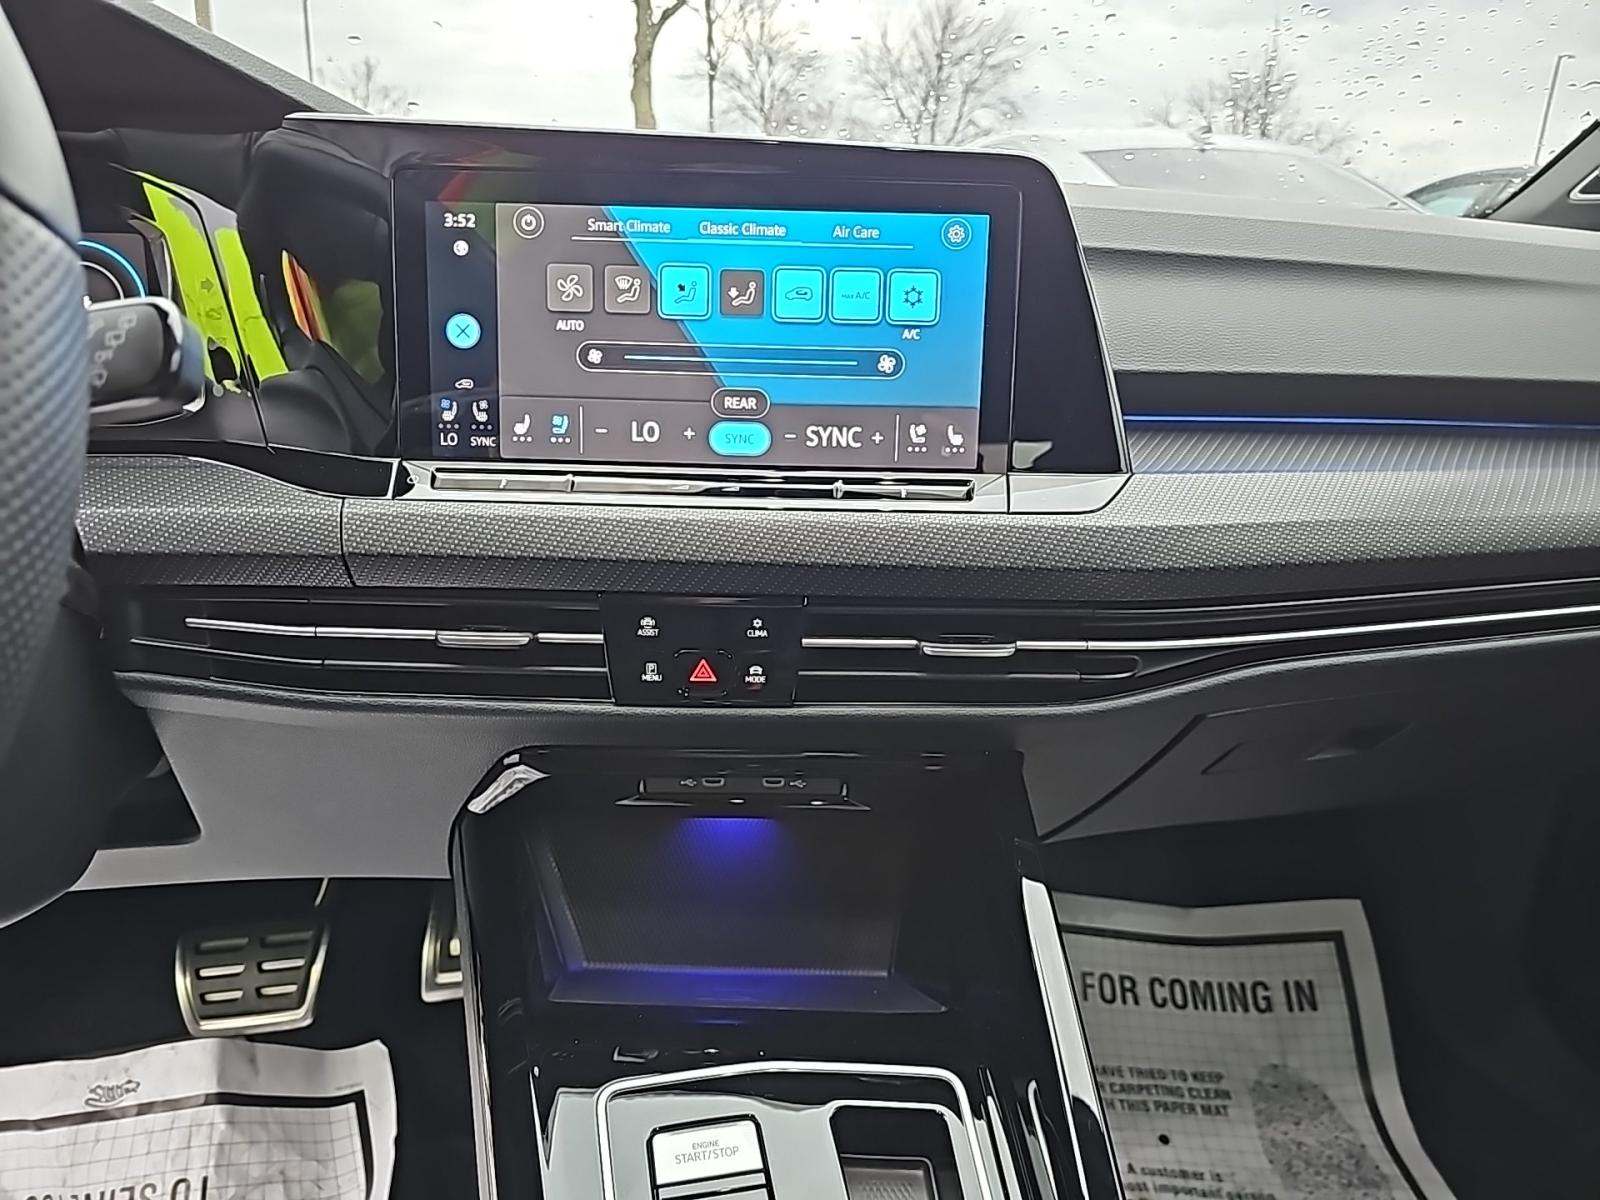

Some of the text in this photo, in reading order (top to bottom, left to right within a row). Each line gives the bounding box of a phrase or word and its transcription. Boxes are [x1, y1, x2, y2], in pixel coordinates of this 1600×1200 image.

[443, 212, 476, 229] 3:52
[587, 218, 671, 234] Smart Climate
[699, 221, 787, 237] Classic Climate
[832, 225, 880, 240] Air Care
[855, 291, 871, 300] A/C
[556, 319, 585, 332] AUTO
[902, 328, 921, 340] A/C
[724, 396, 757, 411] REAR
[440, 432, 459, 447] LO
[631, 421, 661, 444] LO
[724, 432, 755, 446] SYNC
[805, 424, 863, 449] SYNC
[470, 436, 497, 448] SYNC
[637, 628, 660, 637] ASSIST
[747, 629, 768, 638] CLIMA
[641, 673, 662, 682] MENU
[744, 675, 766, 684] MODE
[1081, 971, 1318, 1014] FOR COMING IN
[1170, 1069, 1188, 1082] TO
[691, 1140, 720, 1151] ENGINE
[674, 1145, 740, 1165] START/STOP
